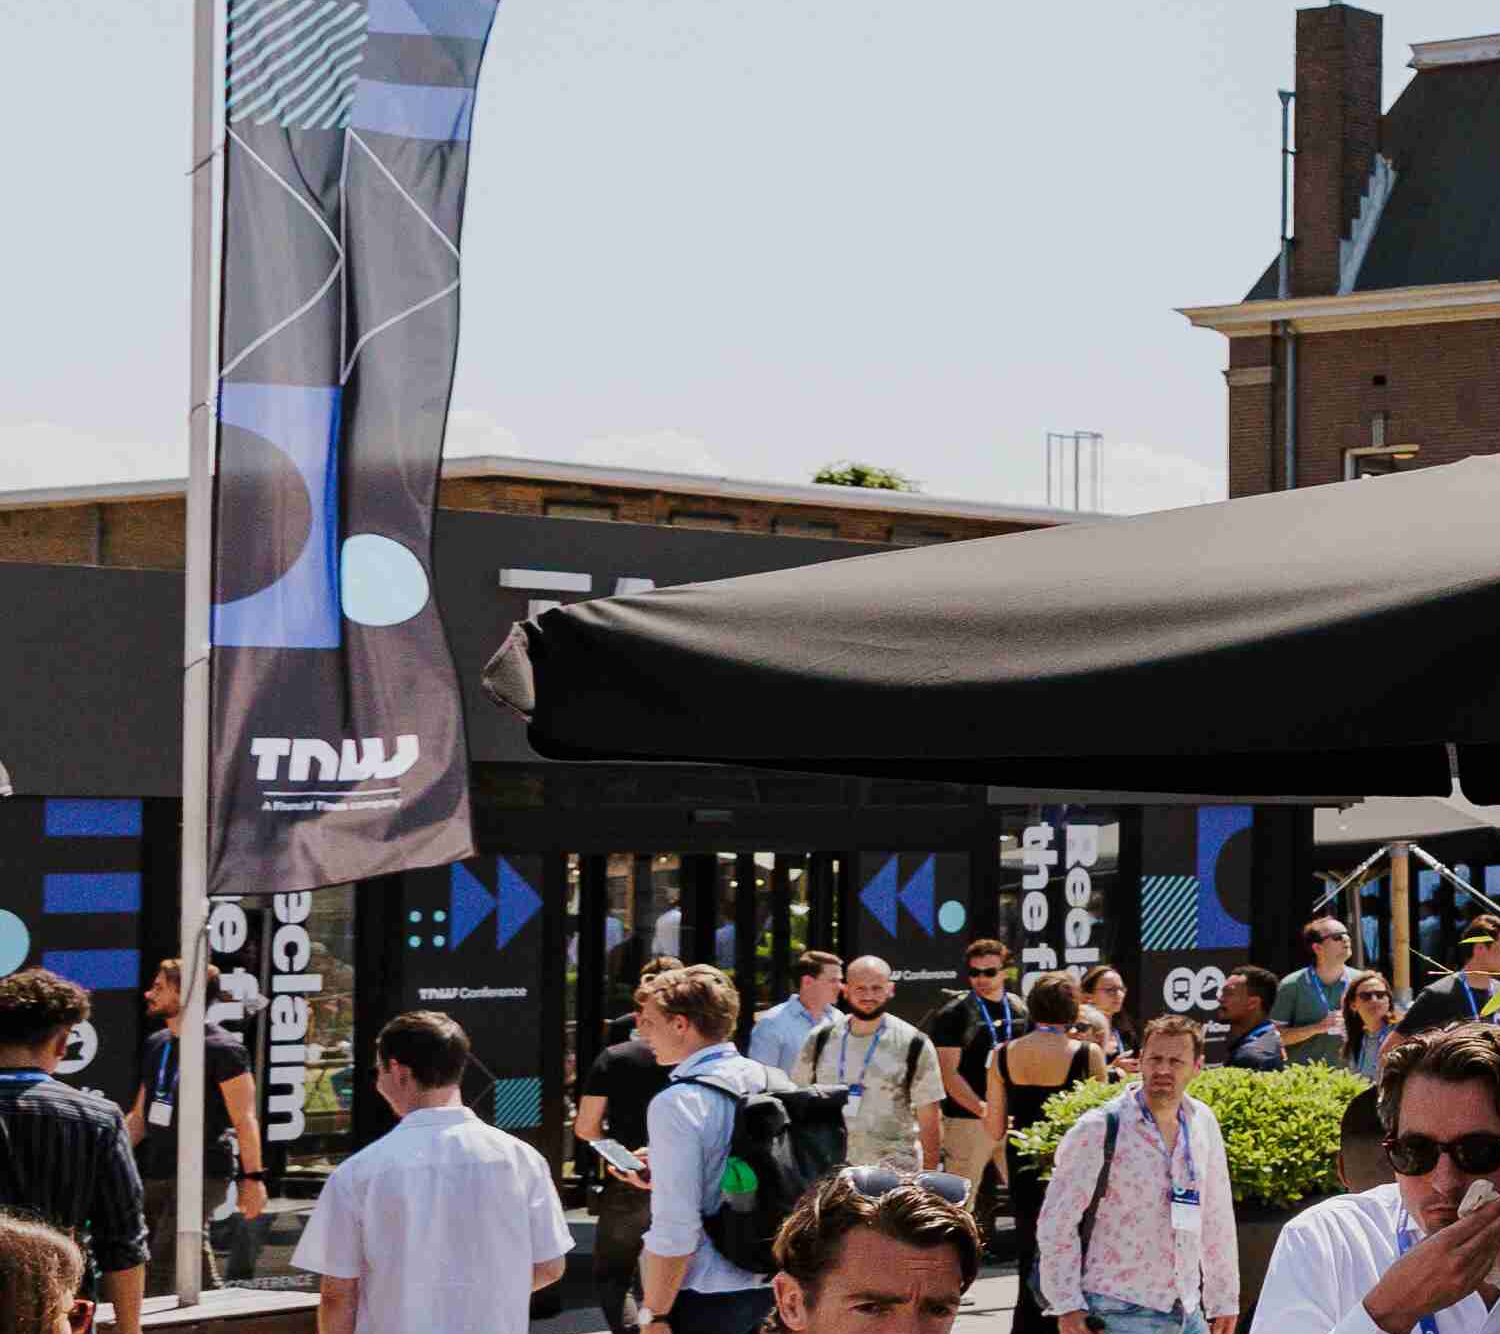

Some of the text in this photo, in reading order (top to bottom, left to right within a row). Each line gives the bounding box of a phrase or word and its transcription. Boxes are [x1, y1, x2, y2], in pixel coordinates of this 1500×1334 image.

[250, 734, 419, 782] TNW
[902, 969, 957, 981] Conference
[459, 986, 528, 1000] Conference
[267, 891, 323, 1142] eclaim
